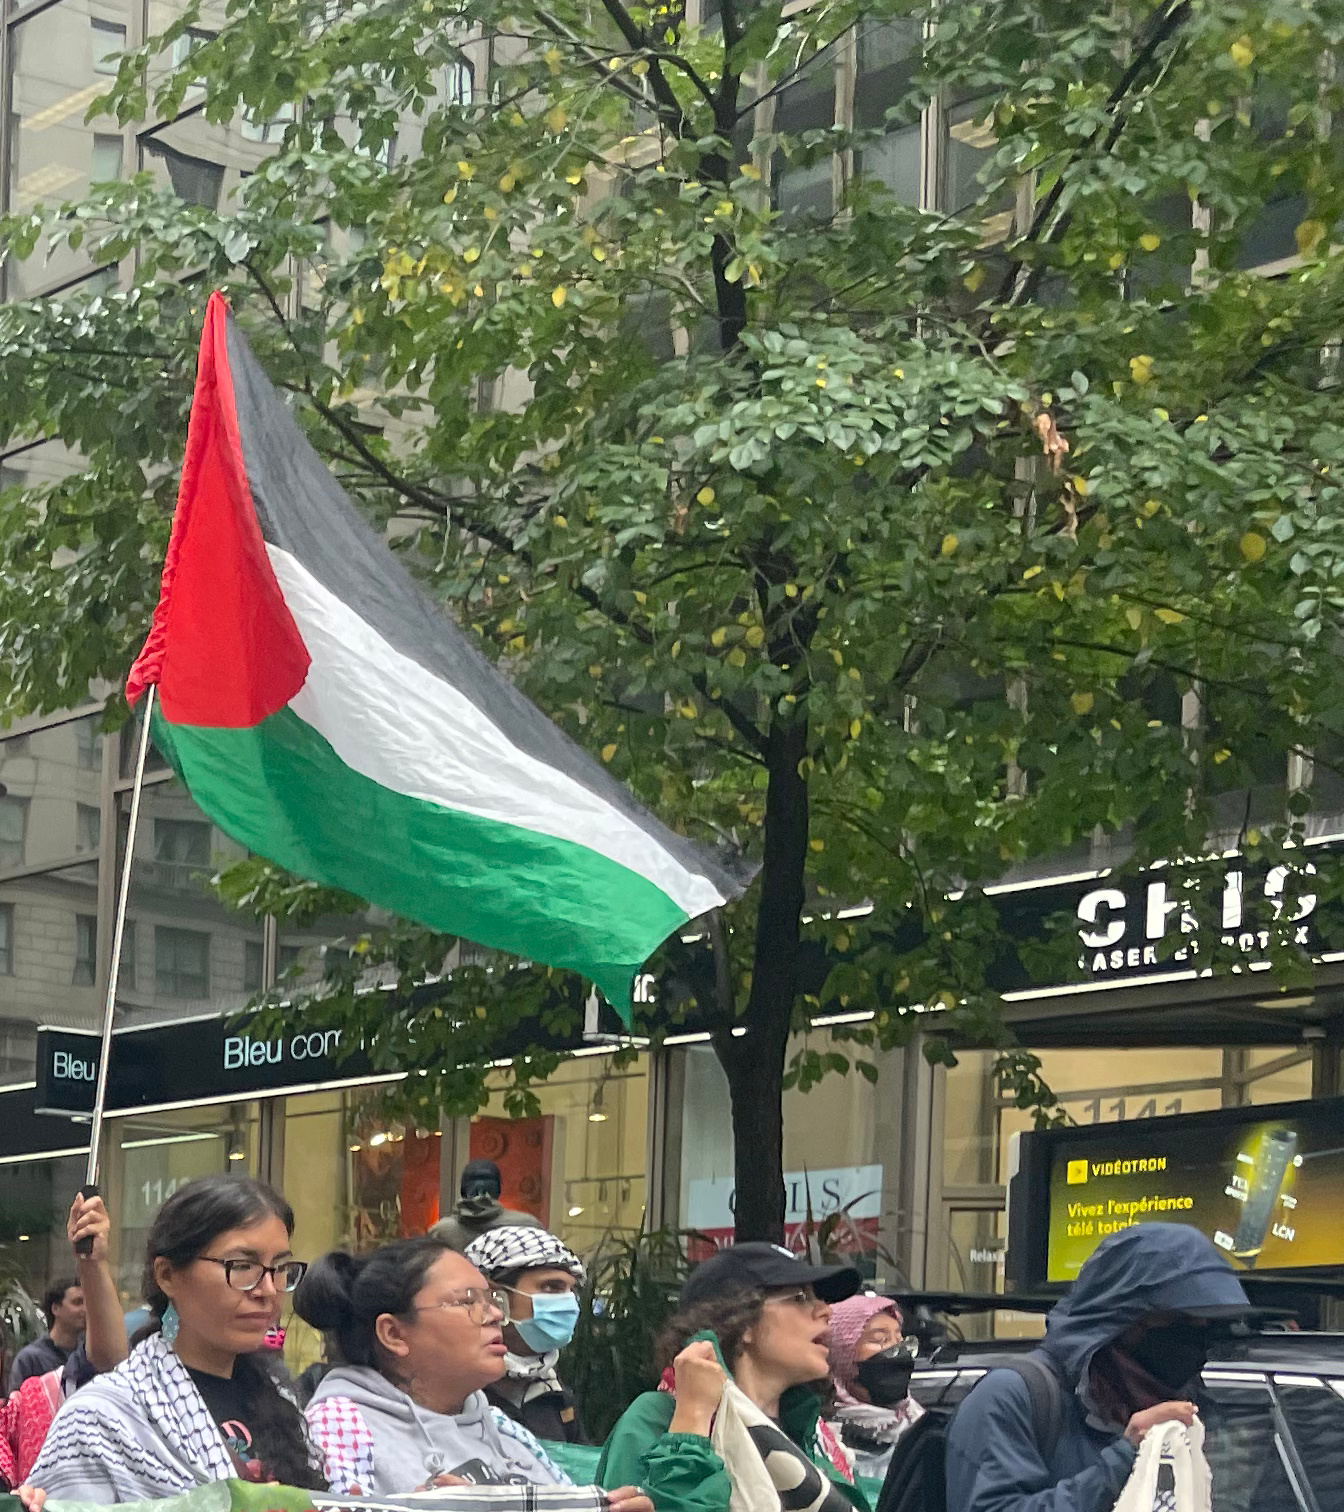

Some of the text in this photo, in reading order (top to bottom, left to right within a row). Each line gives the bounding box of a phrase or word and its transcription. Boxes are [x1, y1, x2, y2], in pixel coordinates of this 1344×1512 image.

[224, 1035, 282, 1070] Bleu
[53, 1051, 95, 1081] Bleu
[1092, 1156, 1167, 1177] VIDÉOTRON
[141, 1177, 191, 1206] 114
[1068, 1195, 1194, 1218] Vivez l'expérience
[1067, 1220, 1093, 1237] télé
